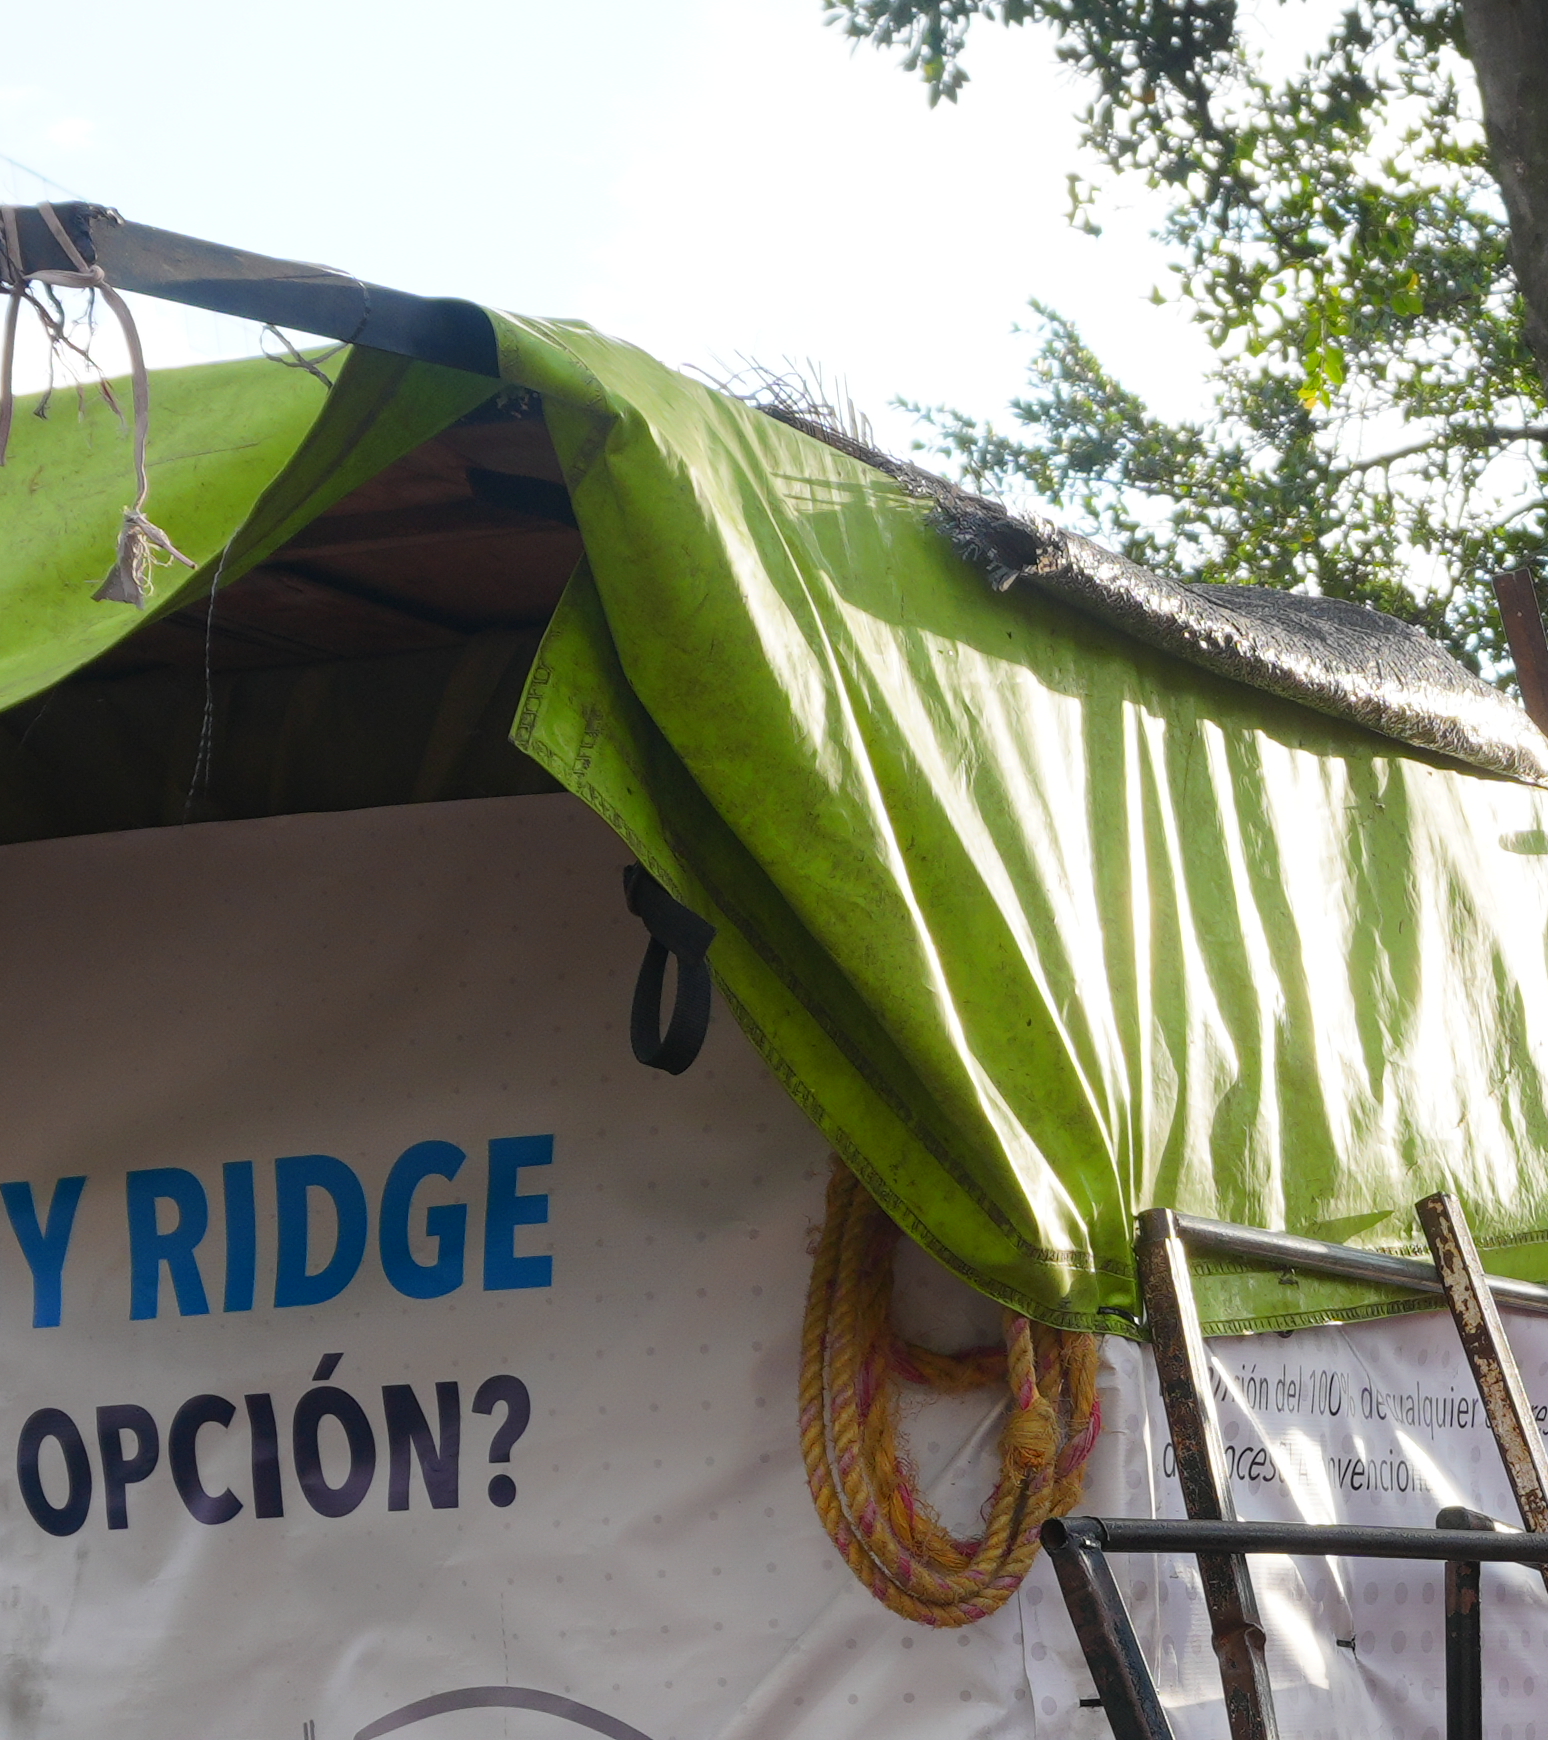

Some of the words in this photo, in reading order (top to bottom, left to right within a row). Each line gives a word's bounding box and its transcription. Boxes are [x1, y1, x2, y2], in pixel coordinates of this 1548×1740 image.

[125, 1133, 555, 1321] RIDGE
[15, 1352, 532, 1538] OPCIÓN?
[1275, 1363, 1302, 1414] del
[1308, 1368, 1355, 1417] 100%
